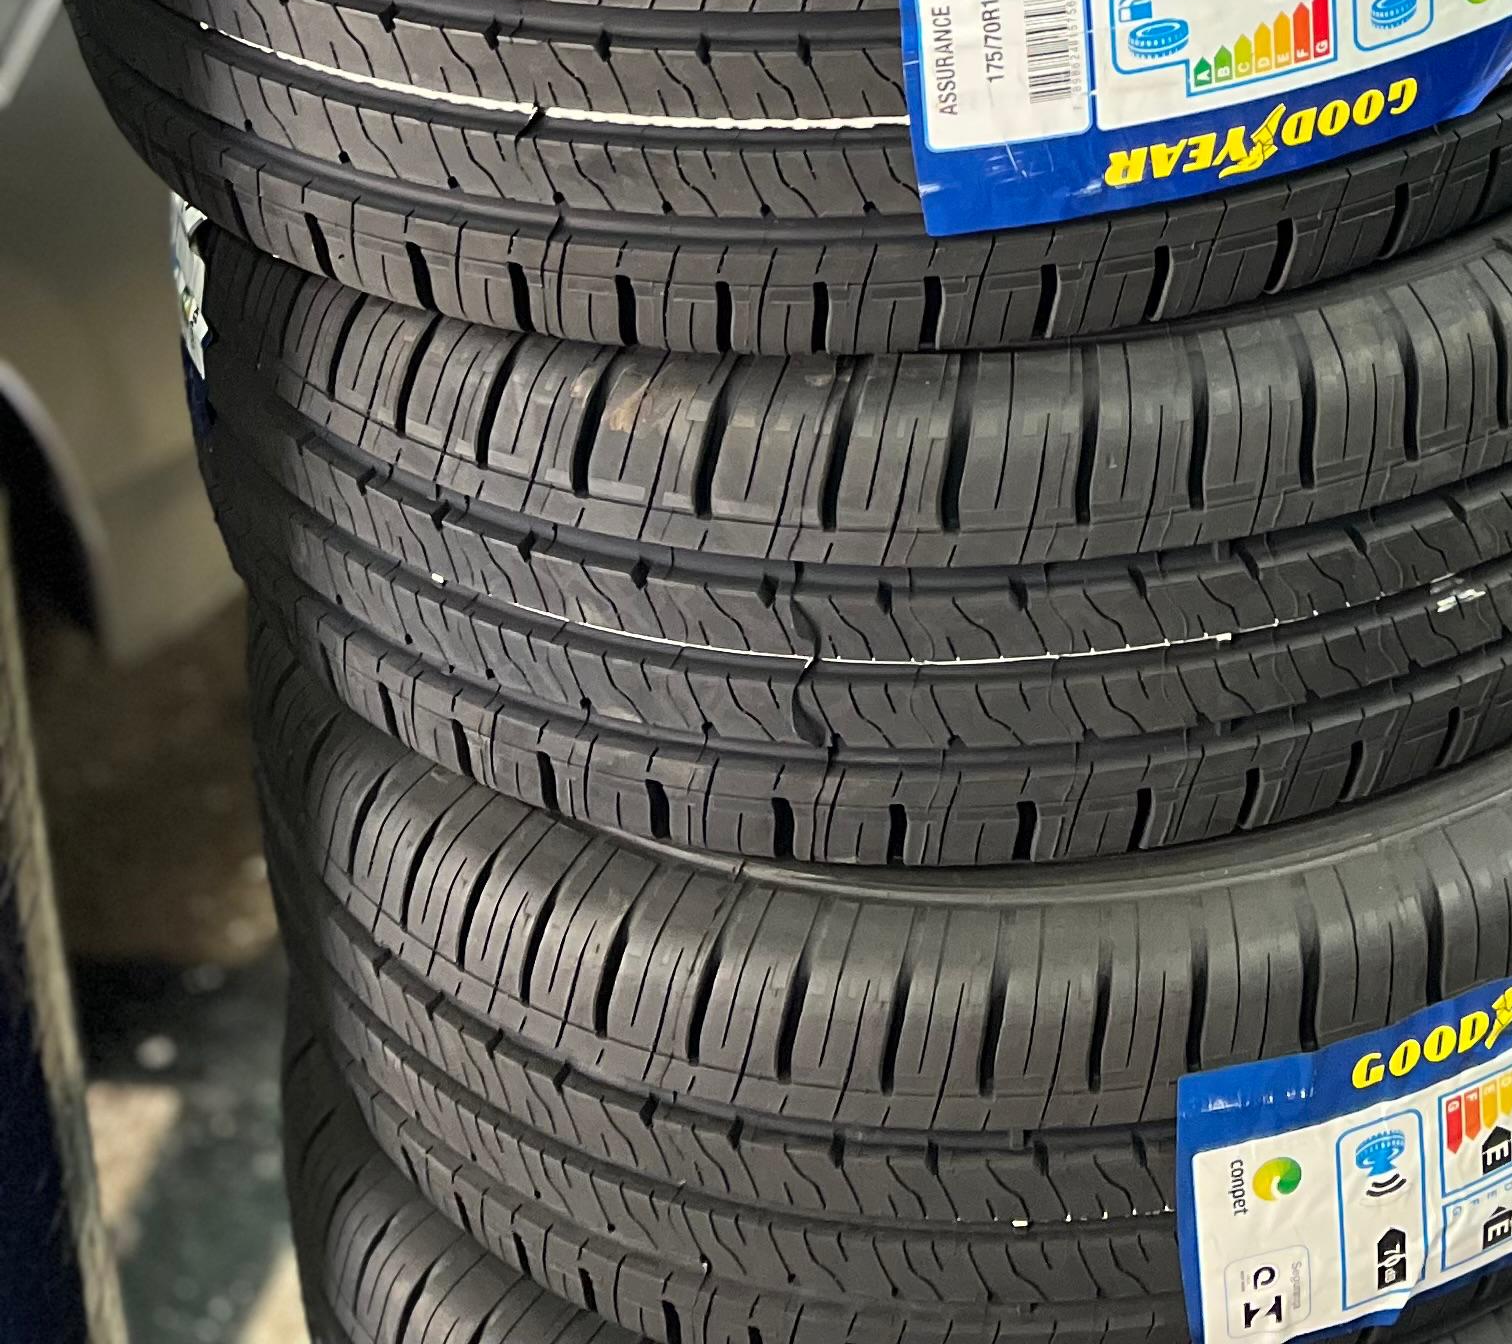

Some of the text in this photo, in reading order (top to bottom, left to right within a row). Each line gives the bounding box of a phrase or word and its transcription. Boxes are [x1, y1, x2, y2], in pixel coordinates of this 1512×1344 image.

[1316, 39, 1328, 53] G
[1277, 52, 1289, 62] E
[1296, 49, 1309, 58] F
[932, 6, 958, 115] ASSURANCE
[1257, 57, 1270, 68] D
[1217, 66, 1230, 77] B
[1238, 62, 1250, 72] C
[1197, 69, 1210, 81] A
[1486, 1140, 1509, 1166] E
[1228, 1159, 1248, 1216] conpet
[1488, 1219, 1510, 1242] E
